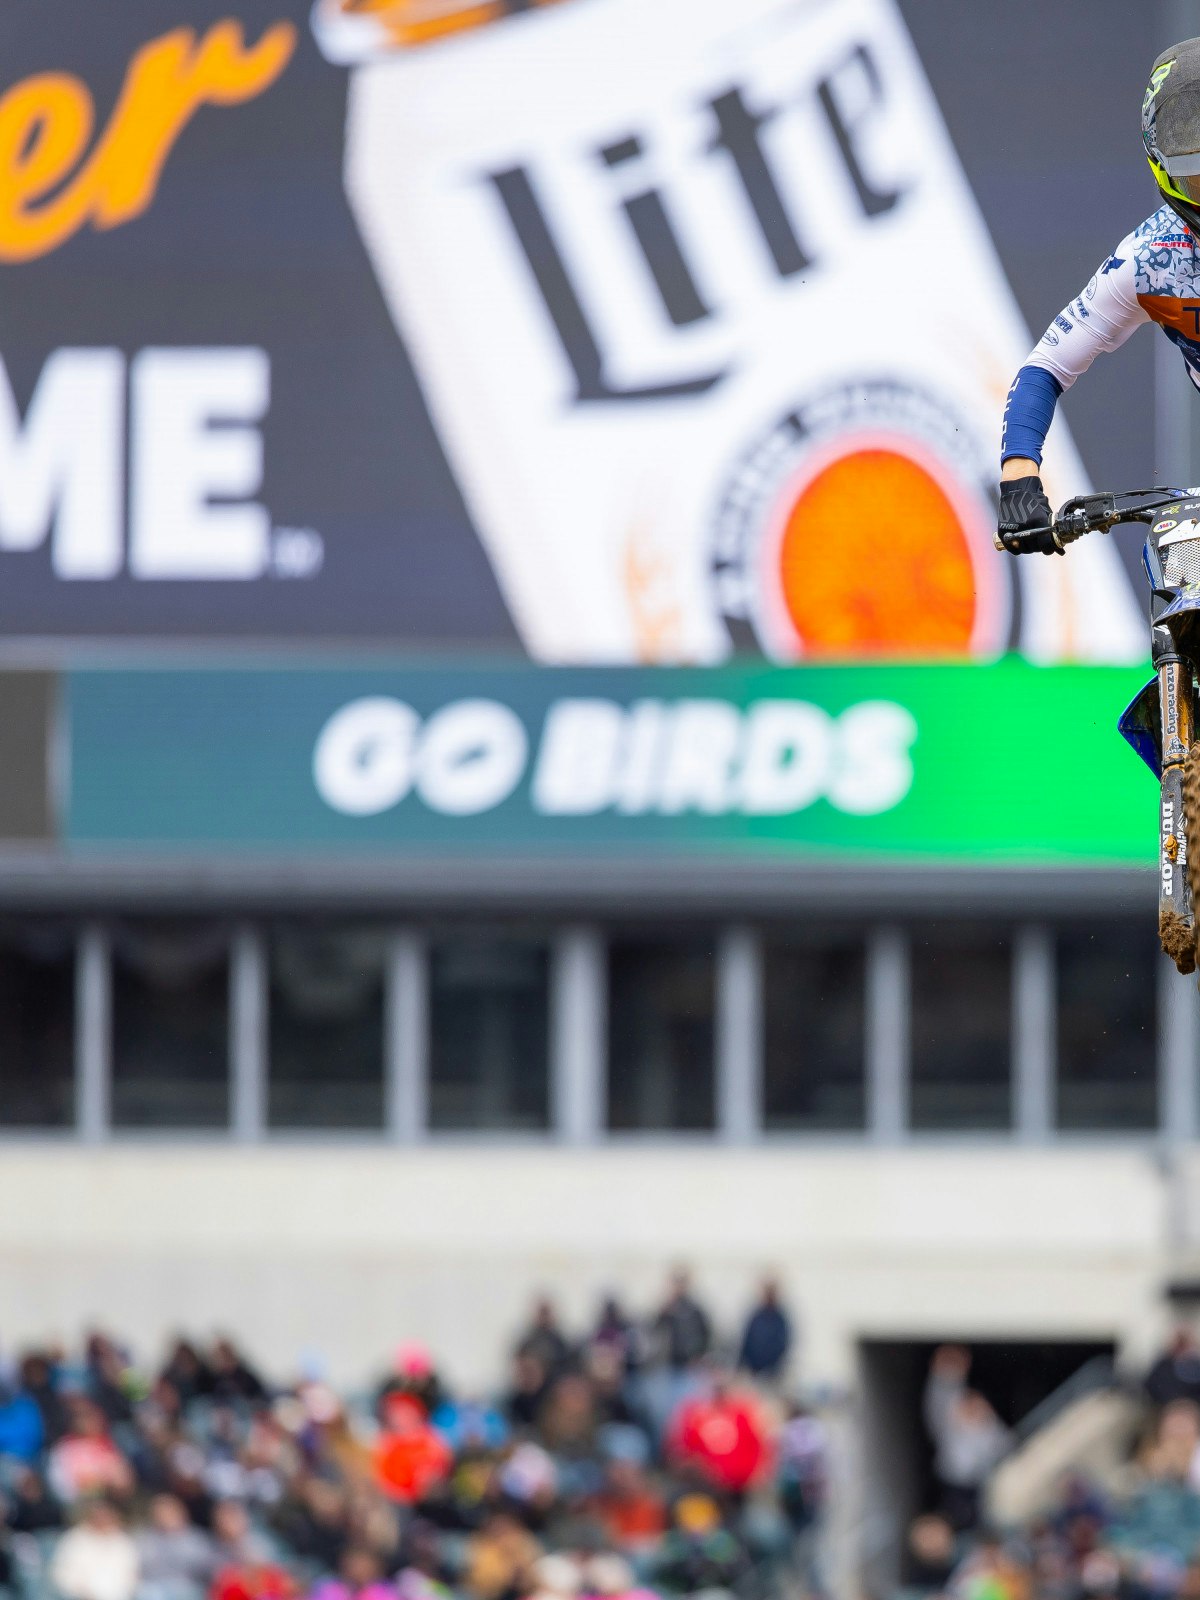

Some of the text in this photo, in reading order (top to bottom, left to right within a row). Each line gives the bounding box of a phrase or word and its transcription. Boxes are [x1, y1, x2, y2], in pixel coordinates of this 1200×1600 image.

[484, 42, 912, 406] Lite
[1152, 234, 1194, 244] PARTS
[312, 695, 918, 817] GO BIRDS
[1176, 831, 1187, 865] CYCRA
